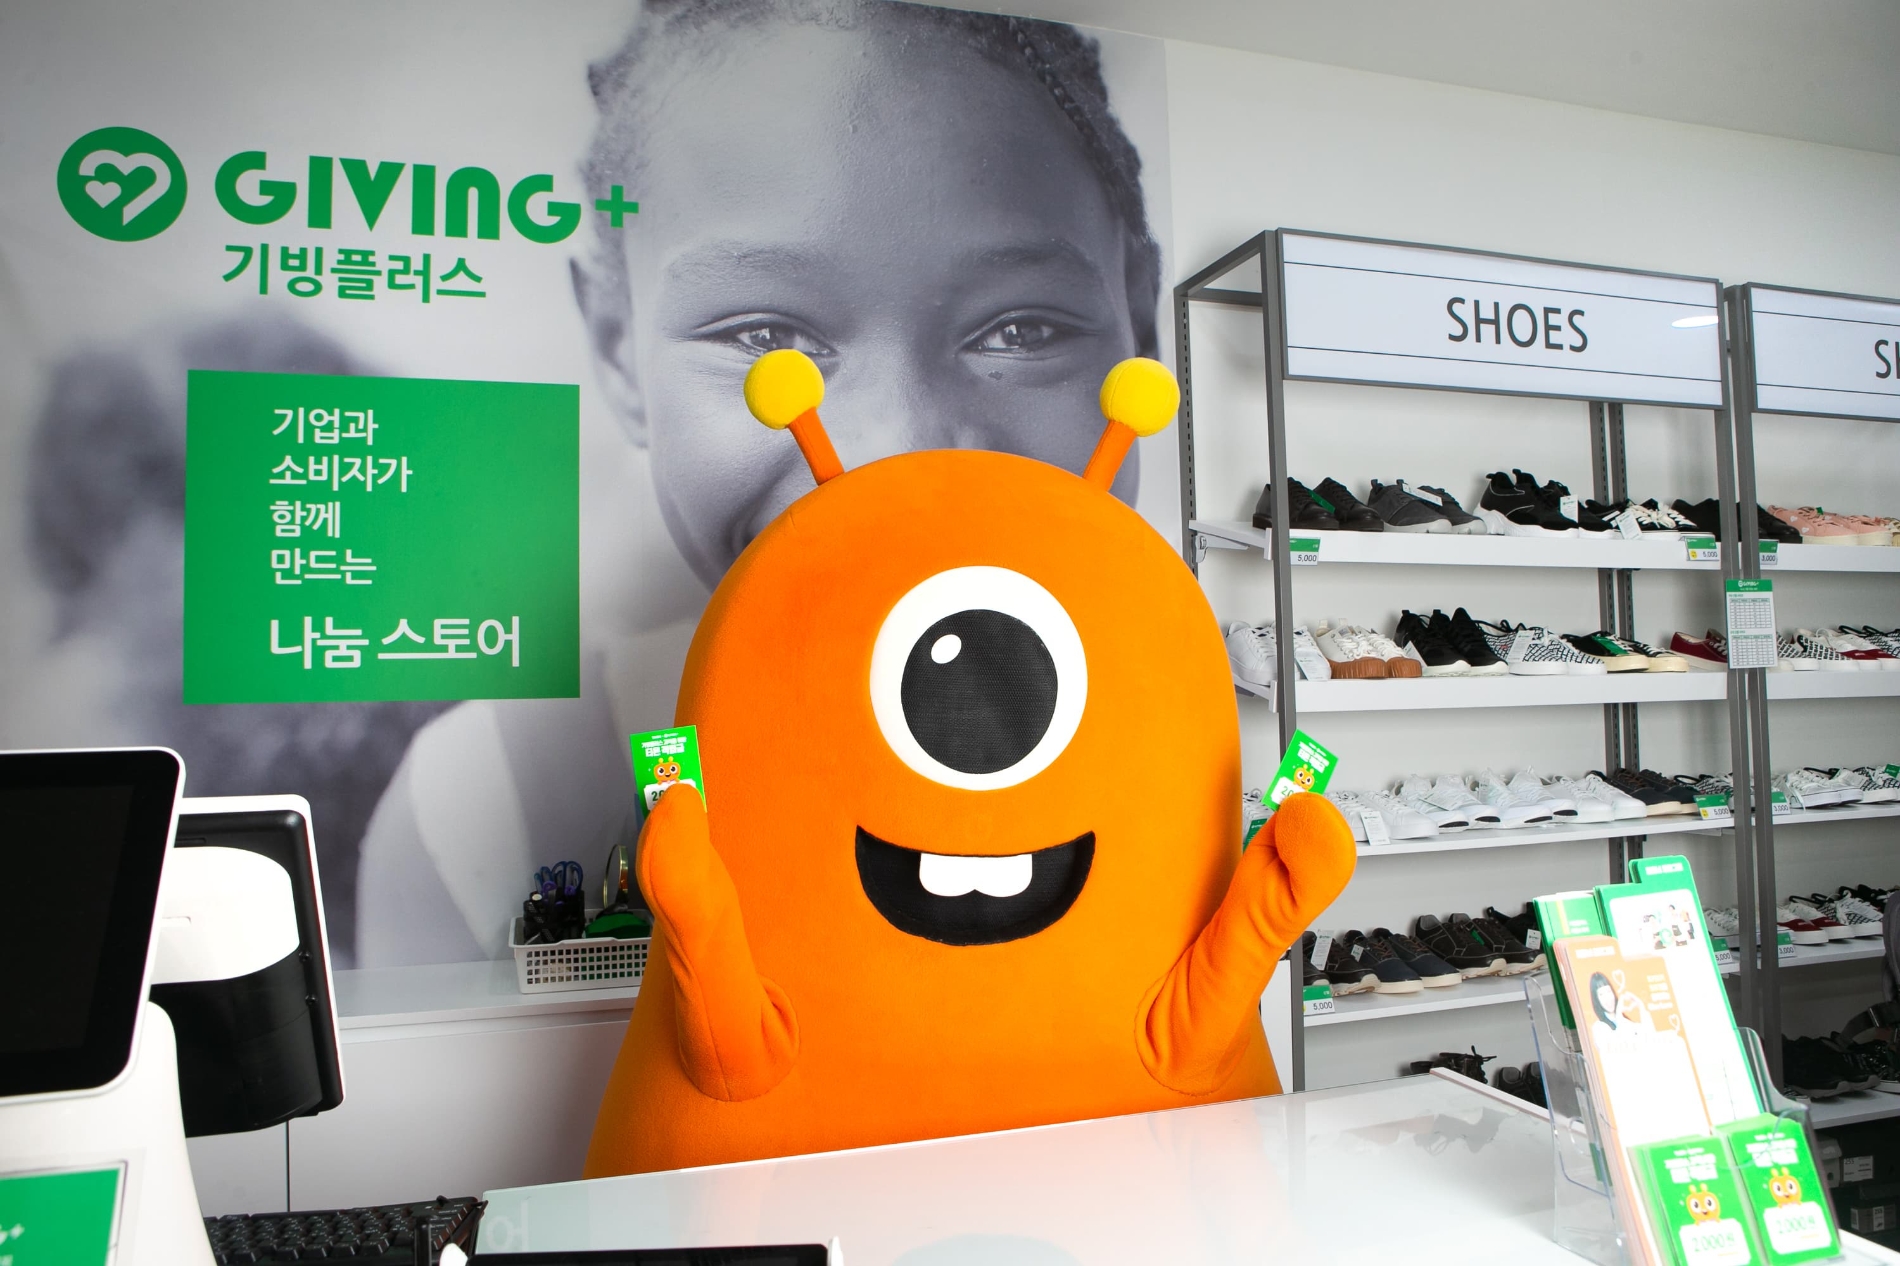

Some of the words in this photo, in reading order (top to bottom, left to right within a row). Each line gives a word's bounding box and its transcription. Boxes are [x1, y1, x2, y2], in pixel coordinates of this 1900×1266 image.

[222, 243, 487, 303] 기빙플러스
[1447, 297, 1588, 352] SHOES
[272, 408, 379, 445] 기업과
[269, 454, 413, 493] 소비자가
[269, 501, 341, 539] 함께
[271, 548, 377, 585] 만드는
[1297, 554, 1317, 563] 5,000
[270, 616, 370, 670] 나눔
[377, 615, 520, 668] 스토어
[1713, 808, 1729, 816] 5,000
[1313, 1001, 1333, 1011] 5,000
